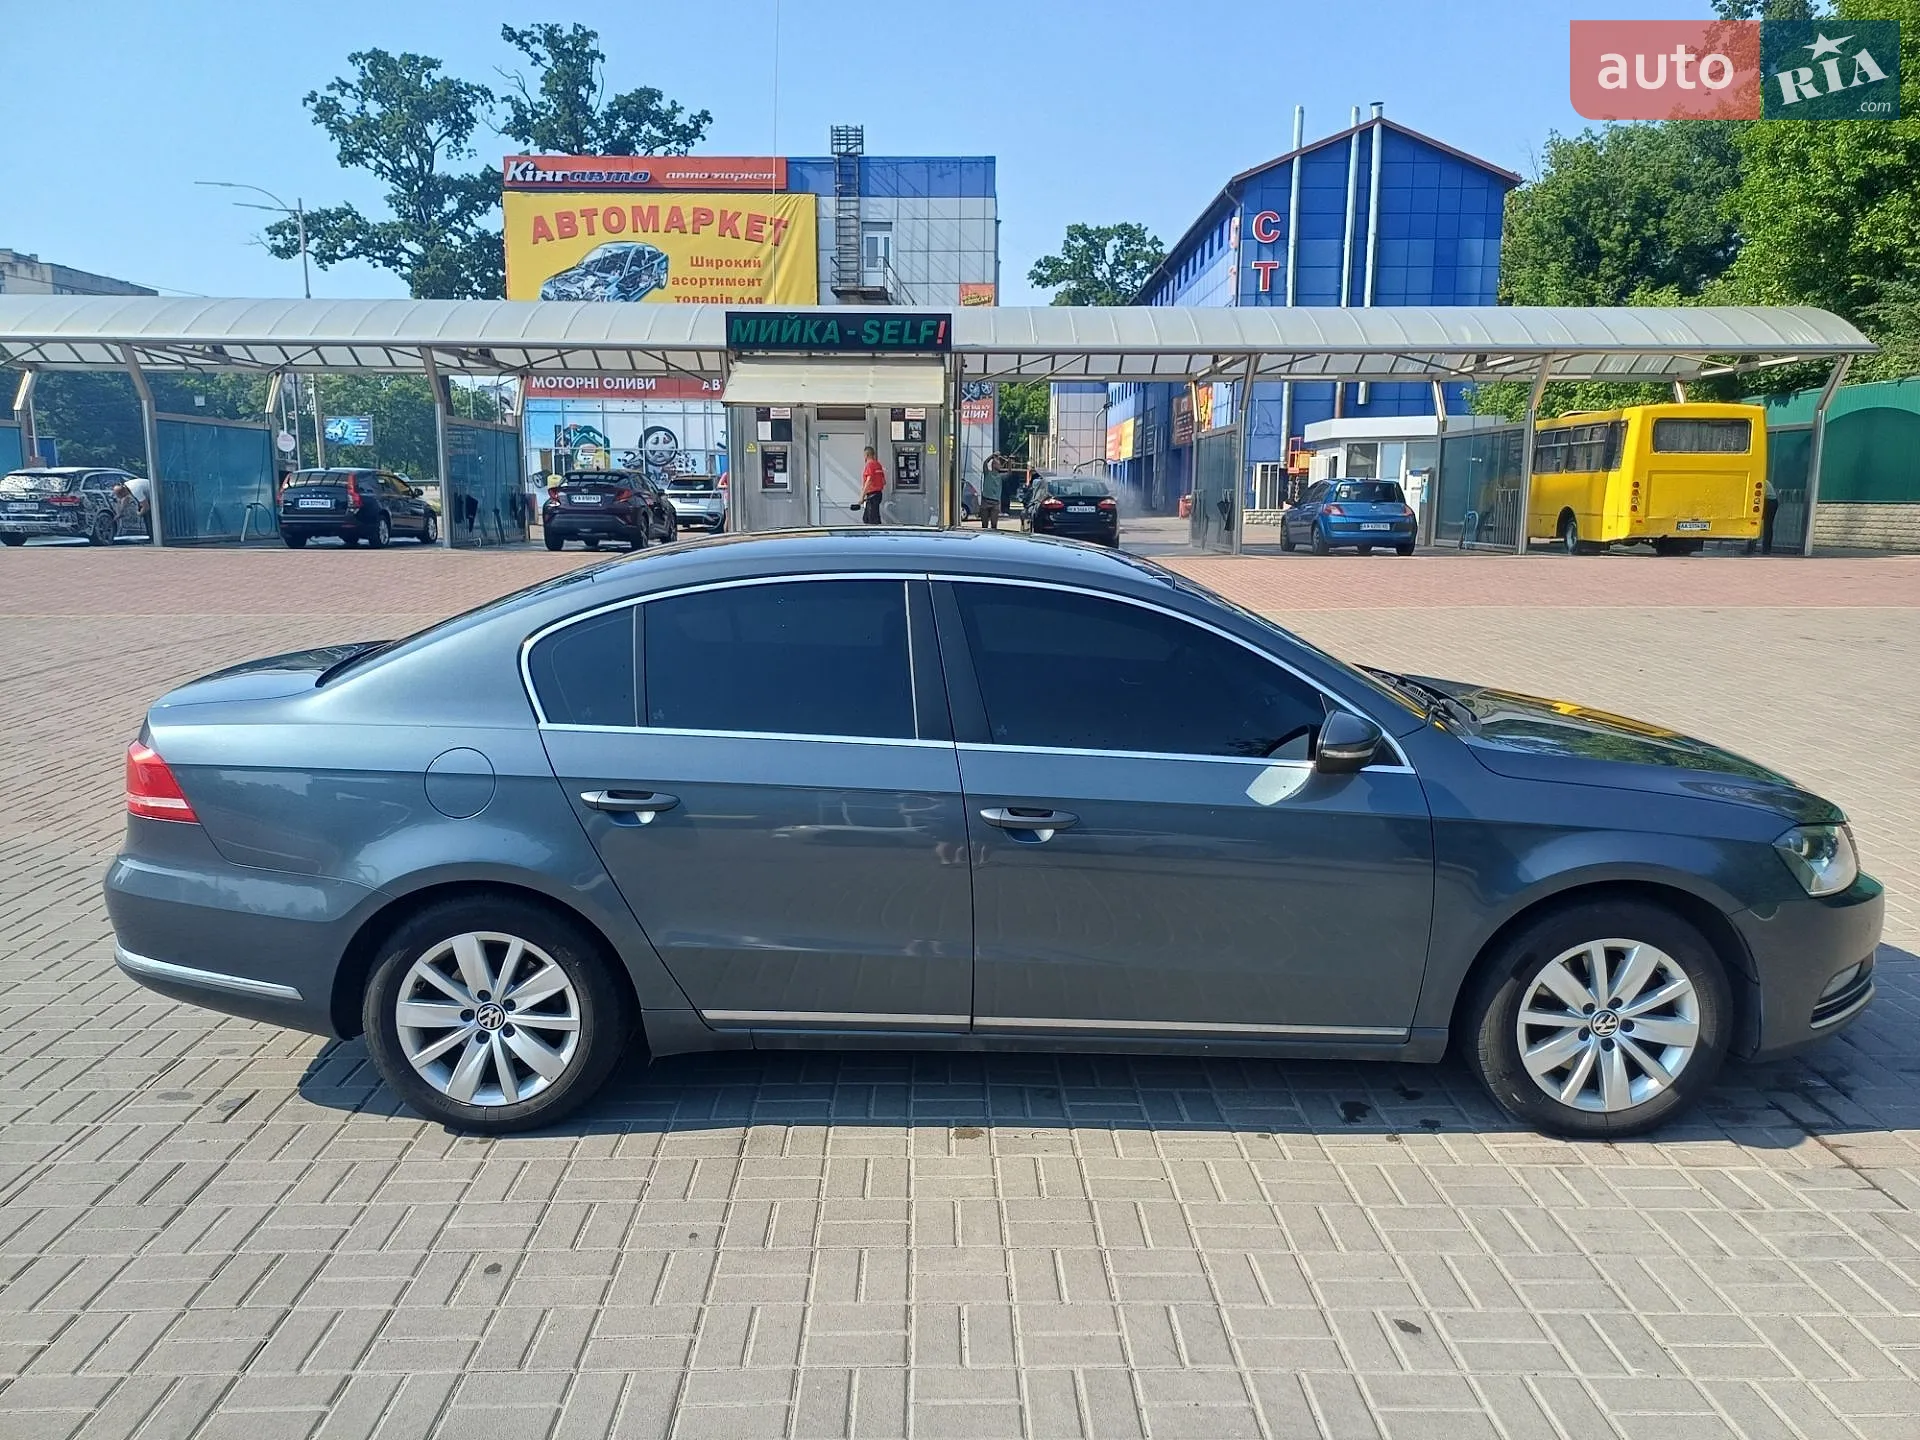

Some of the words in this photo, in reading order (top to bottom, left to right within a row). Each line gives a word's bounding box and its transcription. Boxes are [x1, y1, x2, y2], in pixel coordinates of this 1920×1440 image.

[532, 206, 789, 247] АВТОМАРКЕТ
[689, 256, 762, 269] Широкий
[671, 276, 763, 288] асортимент
[674, 294, 733, 304] товарів
[731, 314, 840, 344] МИЙКА
[862, 320, 946, 345] SELF!
[531, 376, 599, 389] МОТОРНІ
[603, 378, 656, 390] ОЛИВИ
